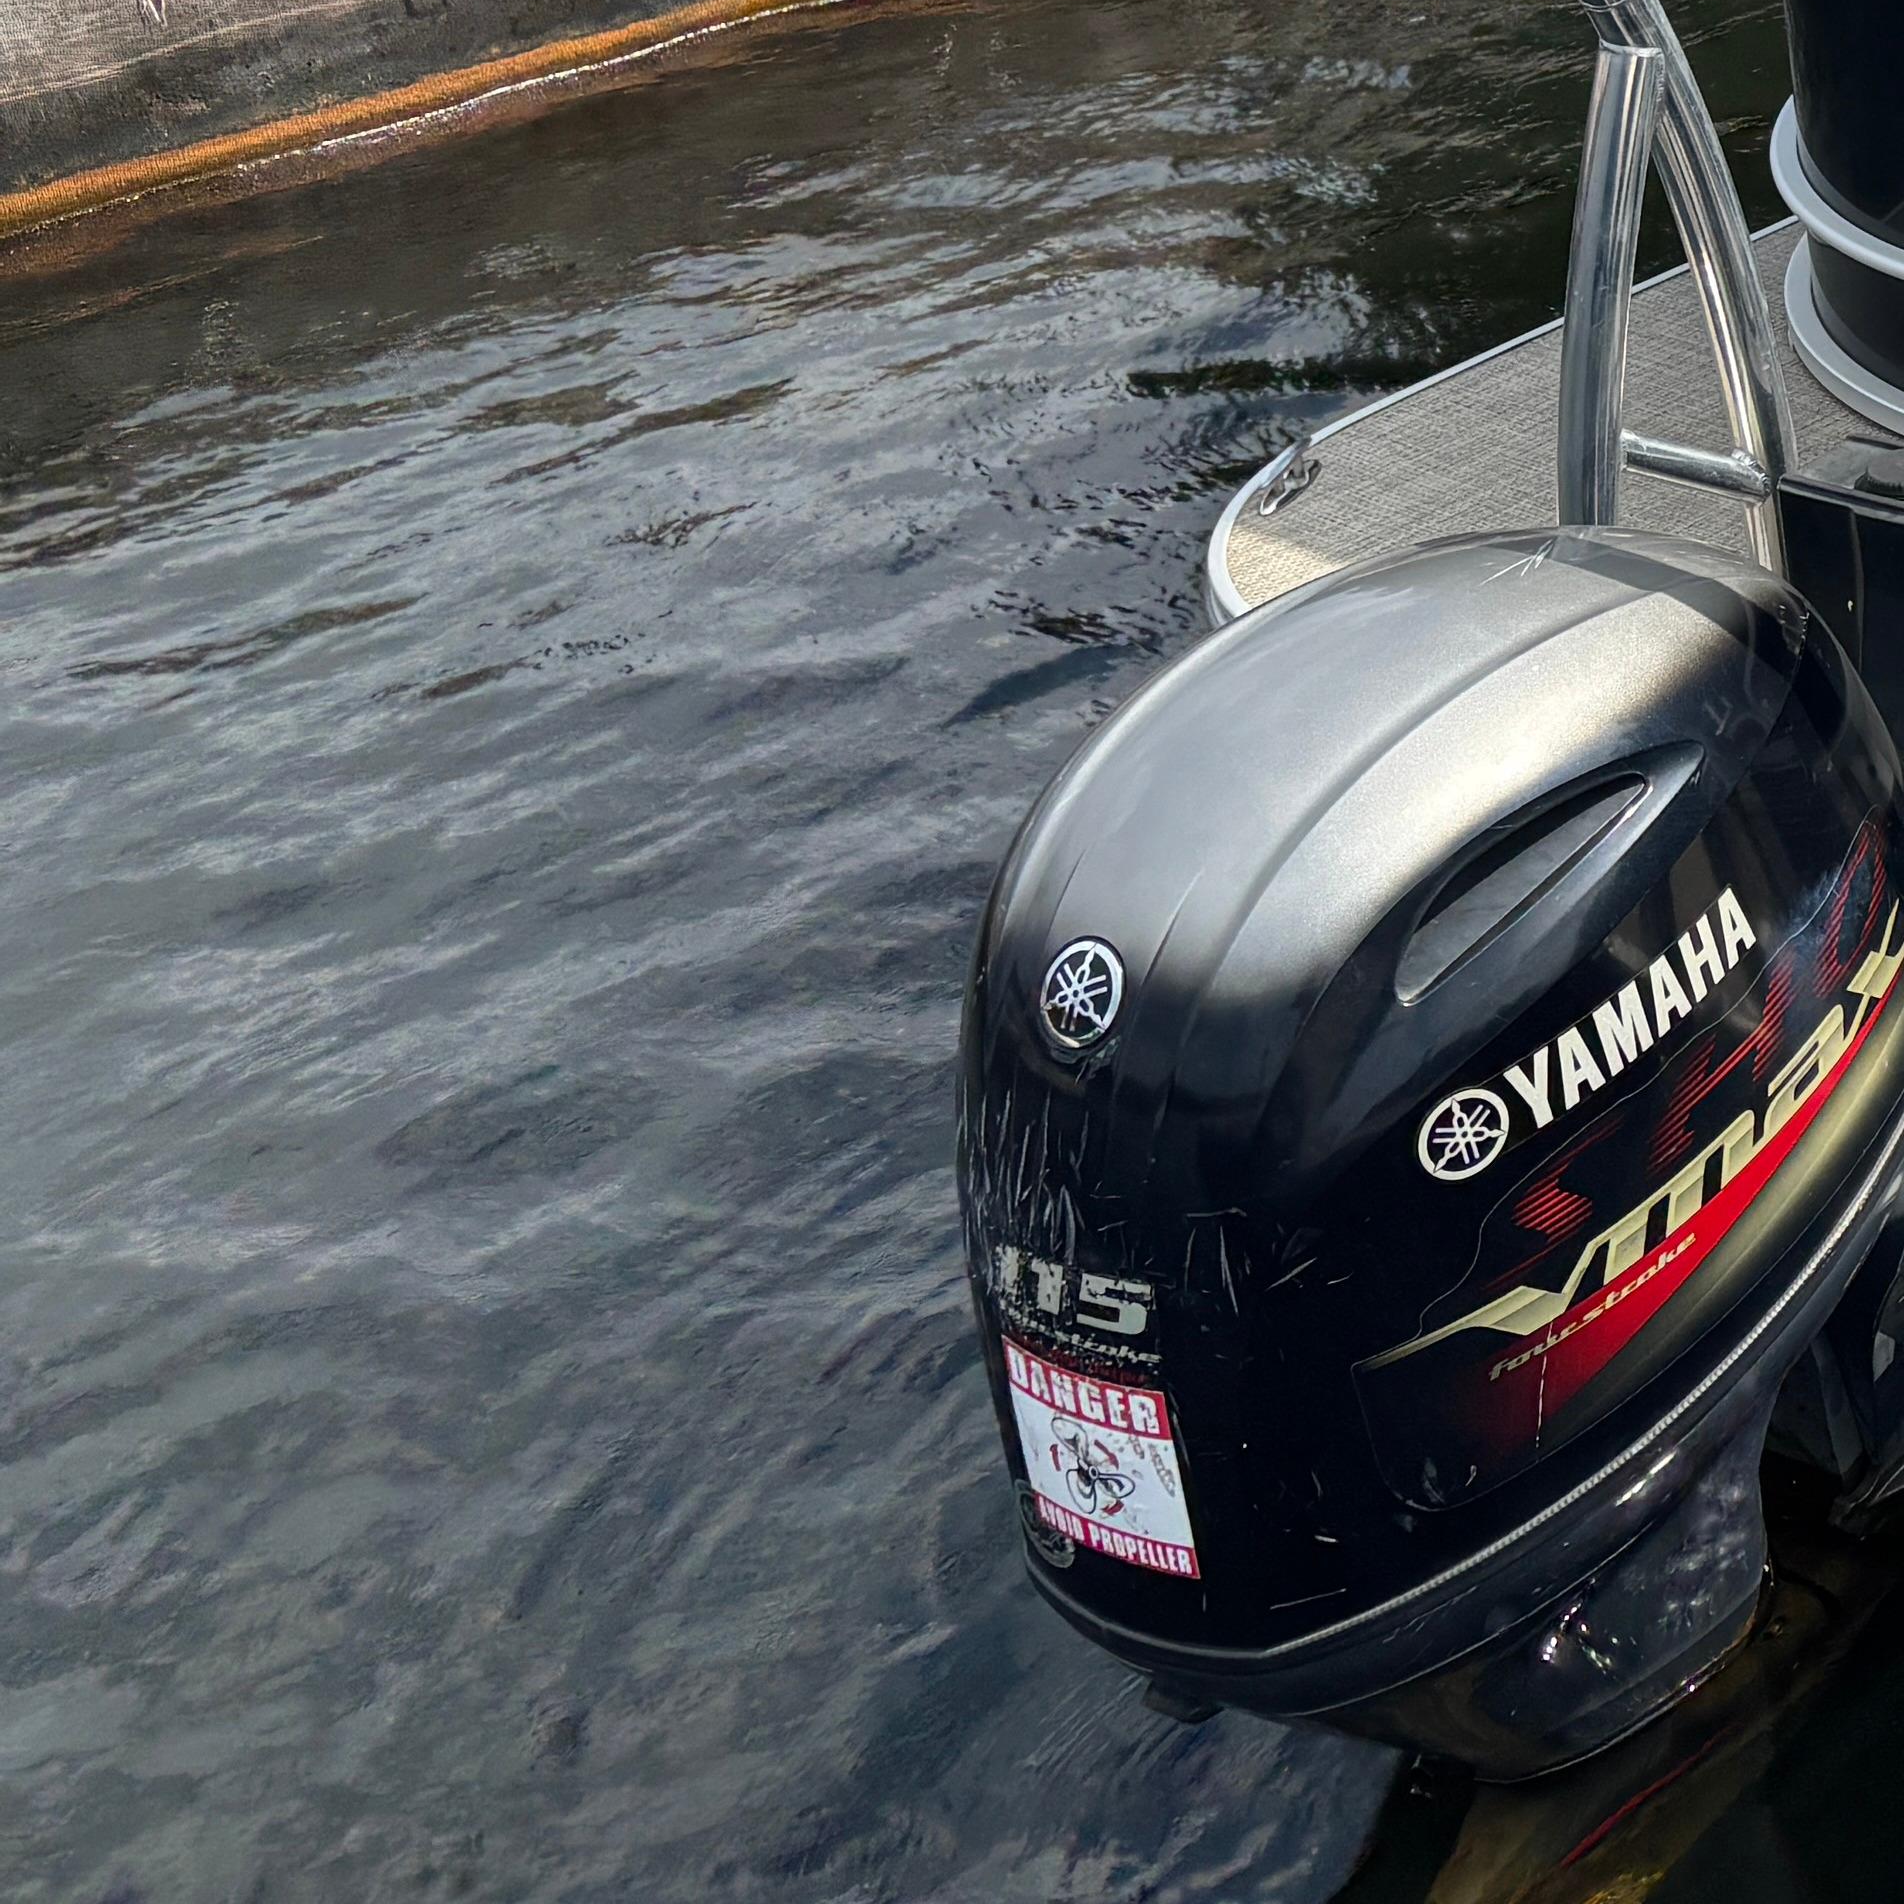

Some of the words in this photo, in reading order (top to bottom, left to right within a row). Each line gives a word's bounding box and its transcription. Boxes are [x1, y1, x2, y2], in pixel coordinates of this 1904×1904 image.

[1502, 887, 1757, 1128] YAMAHA
[1007, 1347, 1160, 1434] DANGER
[1088, 1523, 1192, 1574] PROPELLER
